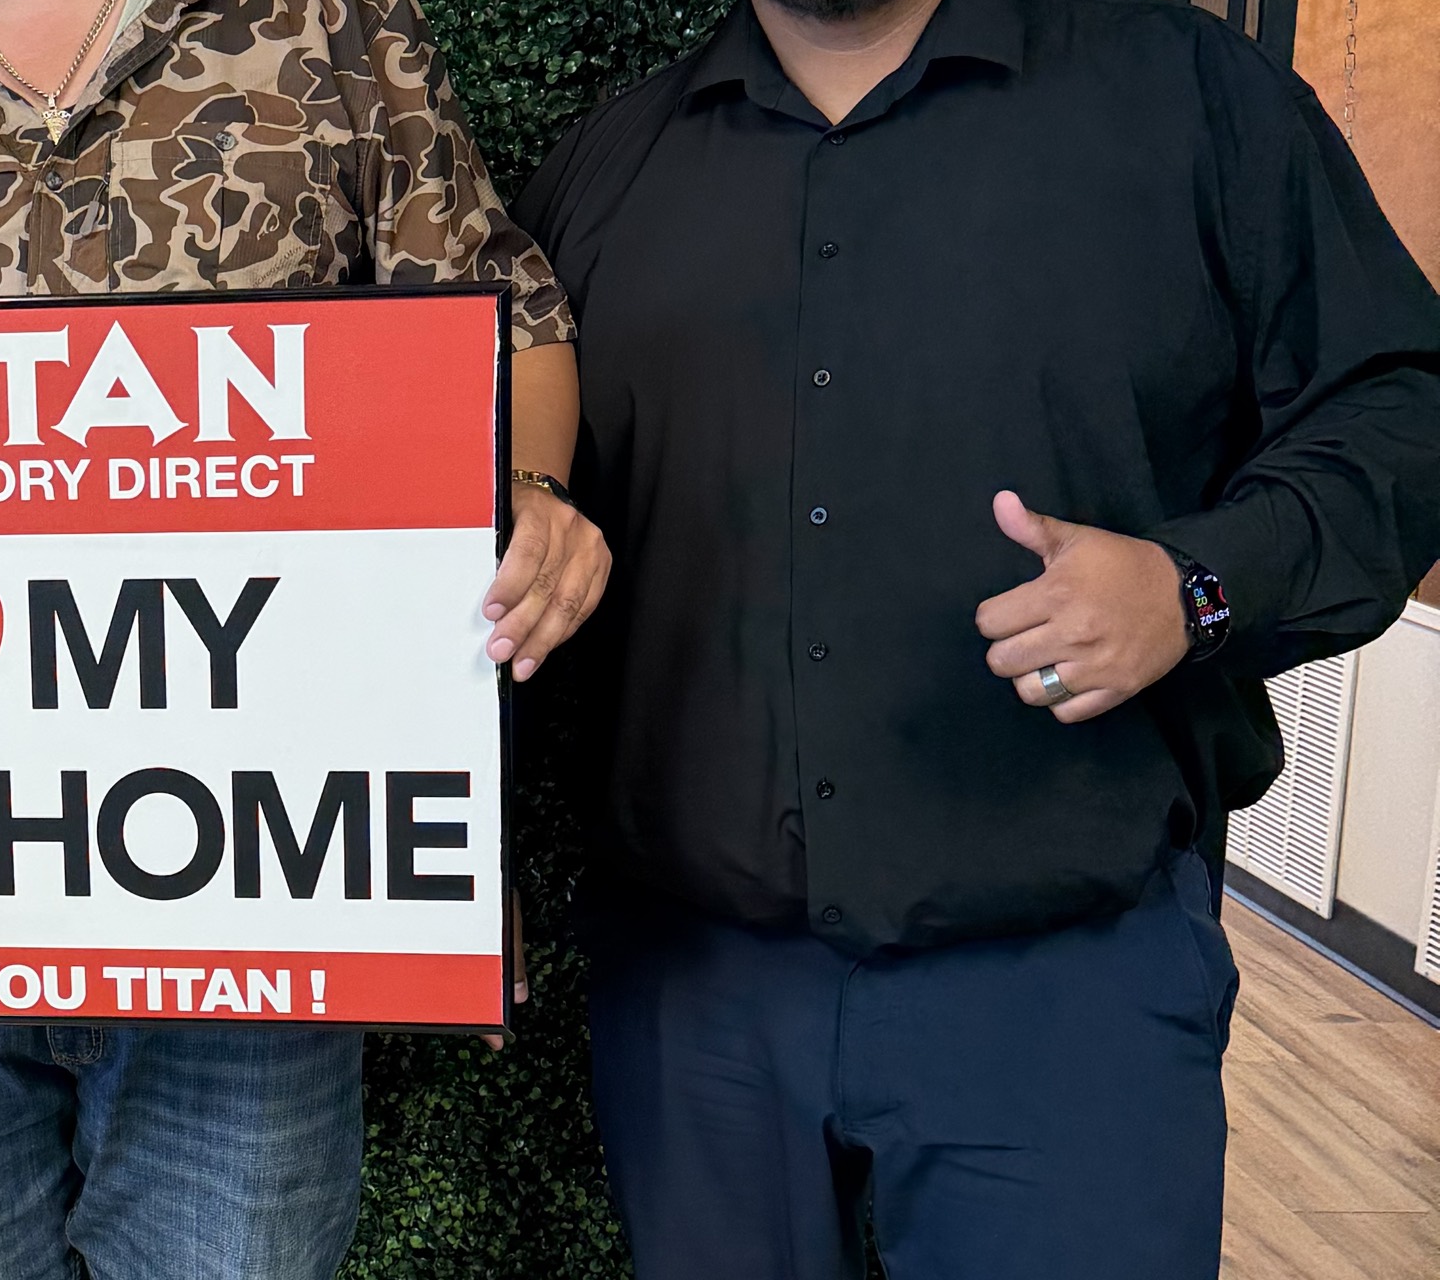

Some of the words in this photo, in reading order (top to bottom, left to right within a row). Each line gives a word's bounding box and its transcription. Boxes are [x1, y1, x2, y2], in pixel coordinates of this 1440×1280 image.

[108, 454, 315, 500] DIRECT
[27, 576, 281, 710] MY
[102, 966, 292, 1014] TITAN
